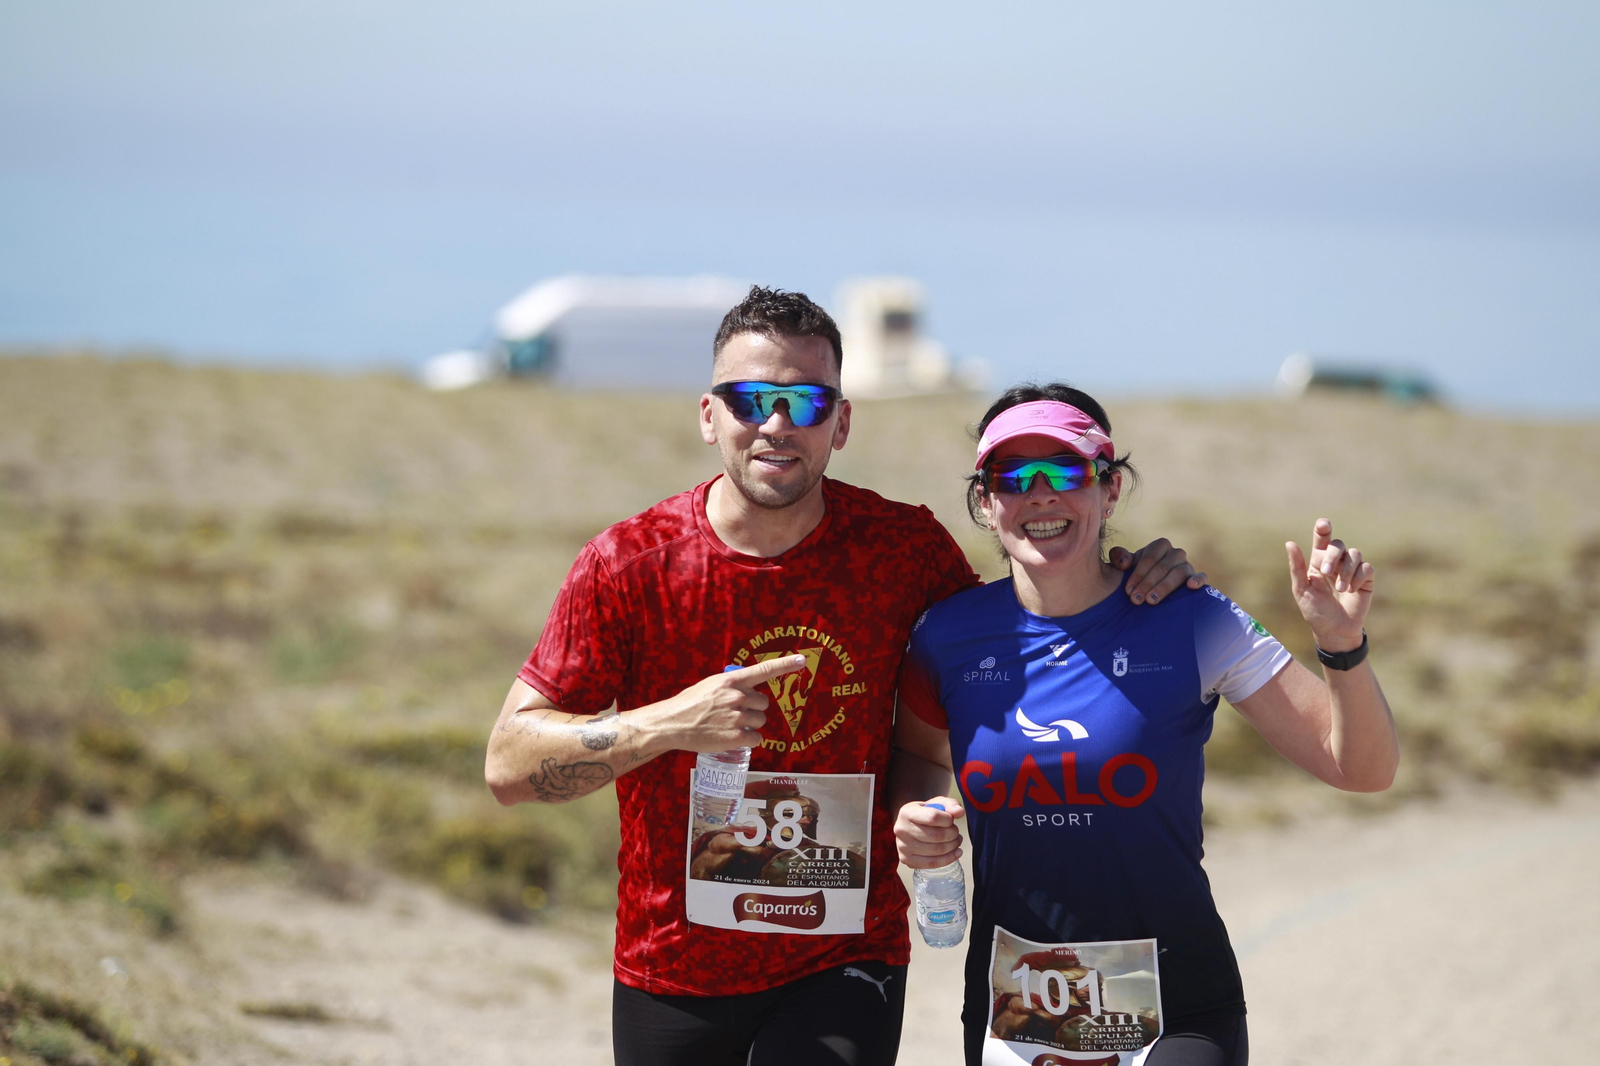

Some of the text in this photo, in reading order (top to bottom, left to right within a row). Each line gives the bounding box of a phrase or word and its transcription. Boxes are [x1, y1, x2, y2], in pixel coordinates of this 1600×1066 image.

[749, 625, 855, 675] MARATONIANO
[963, 671, 1011, 682] SPIRAL
[832, 682, 868, 698] REAL
[959, 752, 1158, 813] GALO
[734, 799, 803, 849] 58
[1022, 813, 1094, 827] SPORT
[789, 847, 850, 860] XIII
[807, 880, 849, 888] ALQUIÁN
[1012, 962, 1102, 1016] 101
[1079, 1013, 1142, 1026] XIII
[1079, 1025, 1143, 1033] CARRERA
